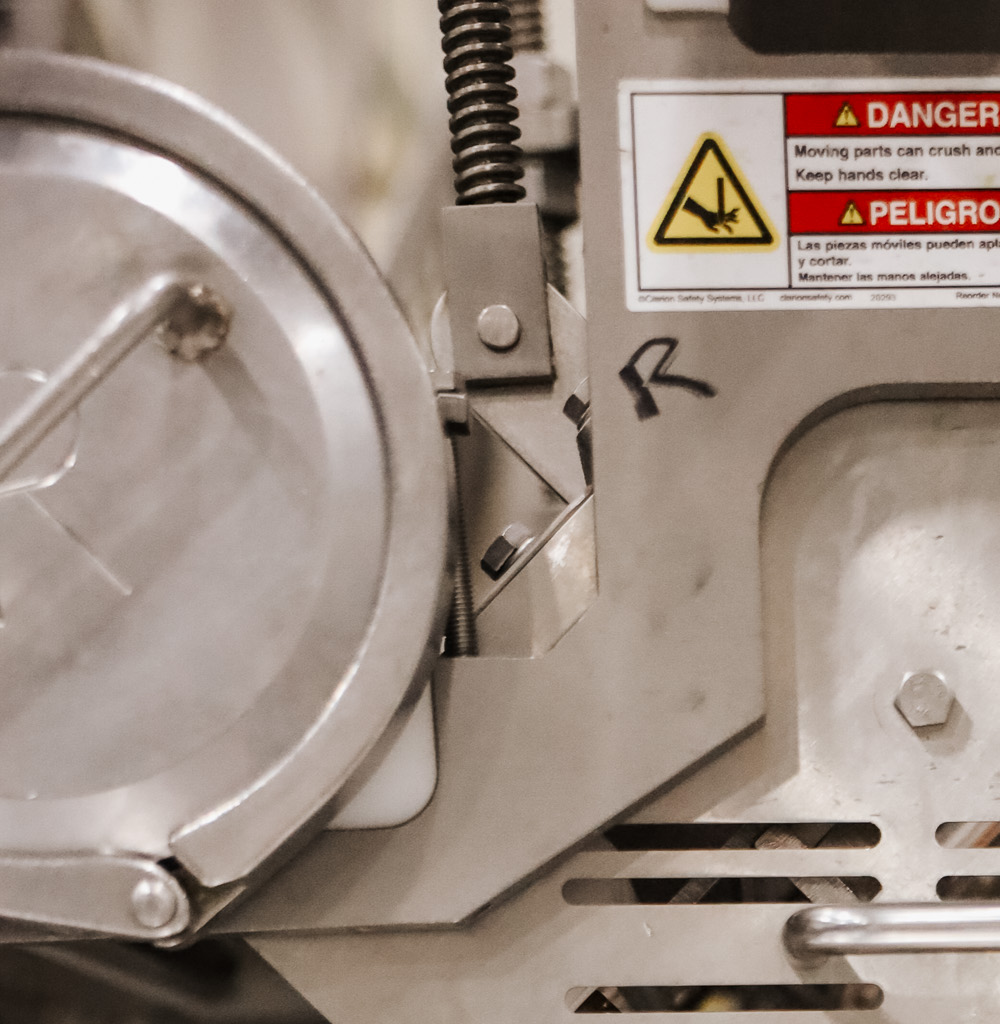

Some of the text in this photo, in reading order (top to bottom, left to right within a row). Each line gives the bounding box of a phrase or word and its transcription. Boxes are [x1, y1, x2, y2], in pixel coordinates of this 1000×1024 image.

[867, 102, 1000, 128] DANGER
[794, 144, 849, 160] Moving
[854, 143, 892, 158] parts
[897, 144, 924, 157] can
[929, 142, 971, 156] crush
[796, 167, 928, 183] Keep hands clear.
[870, 201, 1000, 225] PELIGRO
[798, 241, 821, 250] Las
[826, 241, 867, 253] piezas
[872, 238, 922, 250] móviles
[927, 239, 975, 252] pueden
[798, 255, 852, 268] y cortar.
[799, 270, 971, 283] Mantener las manos alejadas.
[955, 291, 989, 300] Reorder
[619, 337, 718, 421] R
